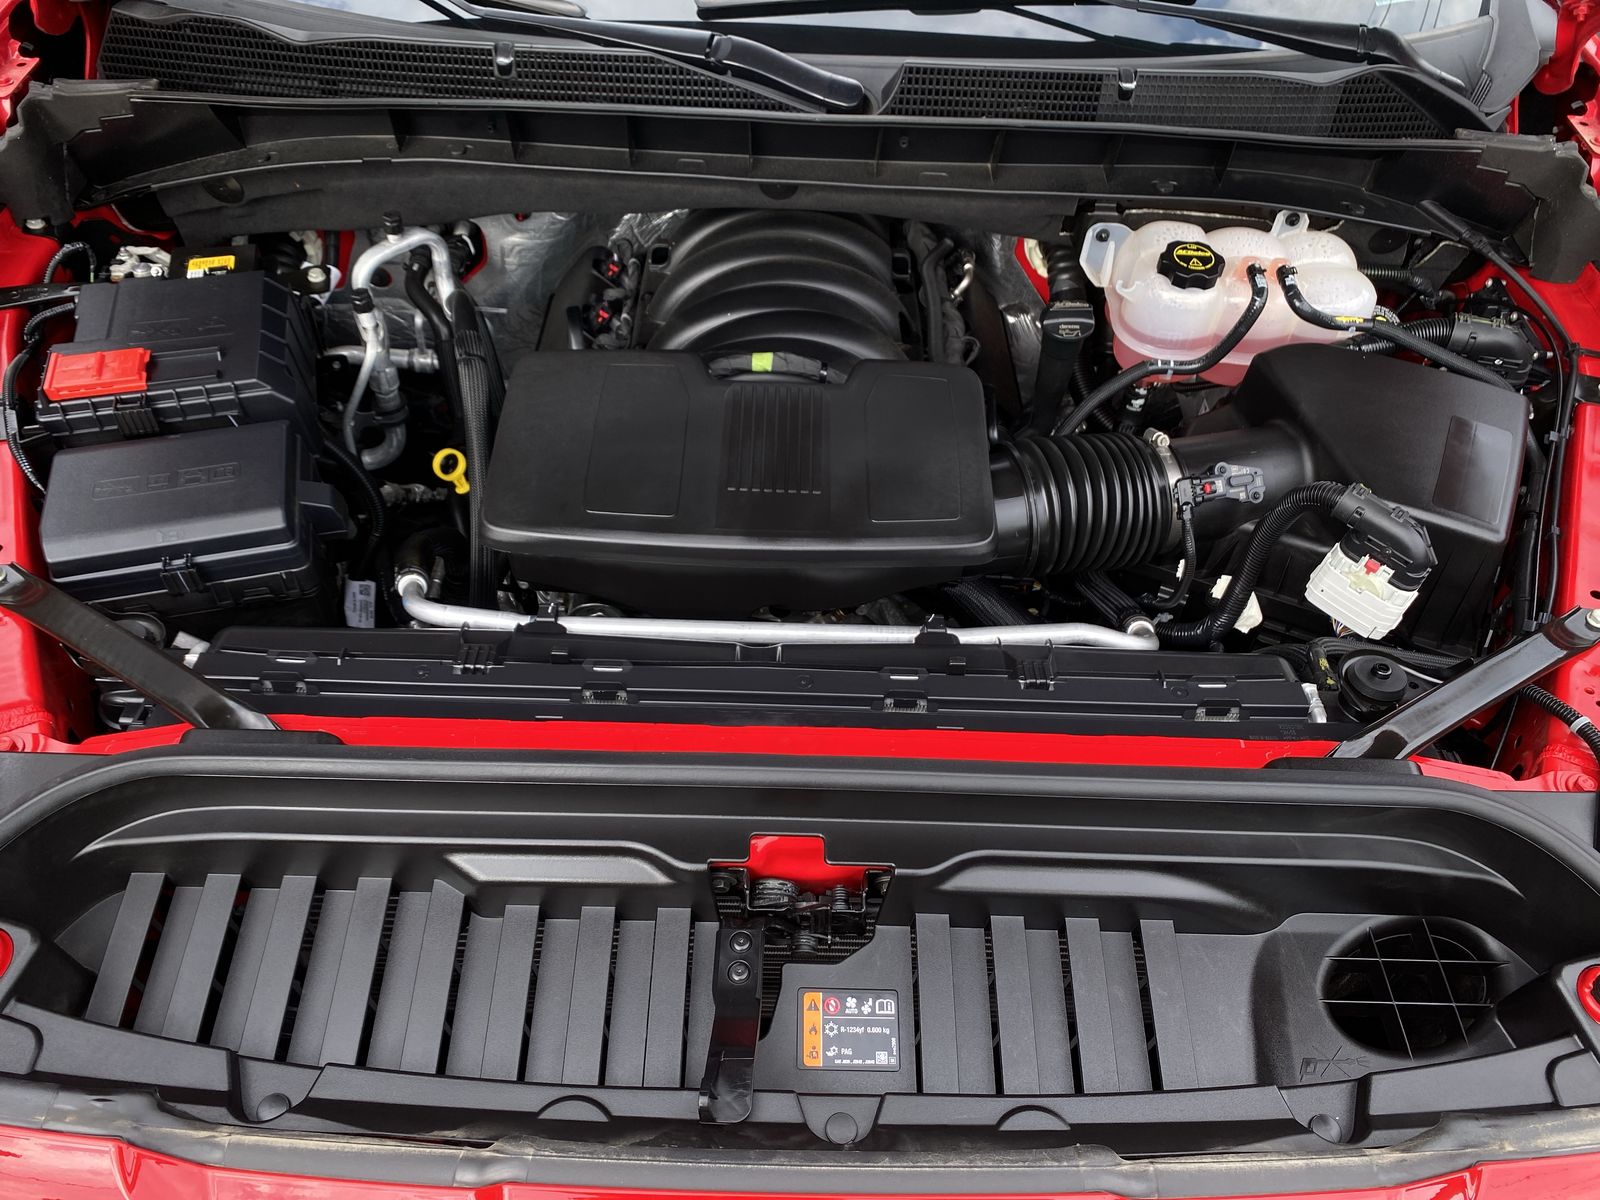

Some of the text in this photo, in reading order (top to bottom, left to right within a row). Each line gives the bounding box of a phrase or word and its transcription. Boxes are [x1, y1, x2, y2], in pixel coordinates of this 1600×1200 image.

[1175, 249, 1211, 257] ACDelco
[840, 1026, 865, 1034] R-1234yf
[882, 1026, 890, 1034] kg
